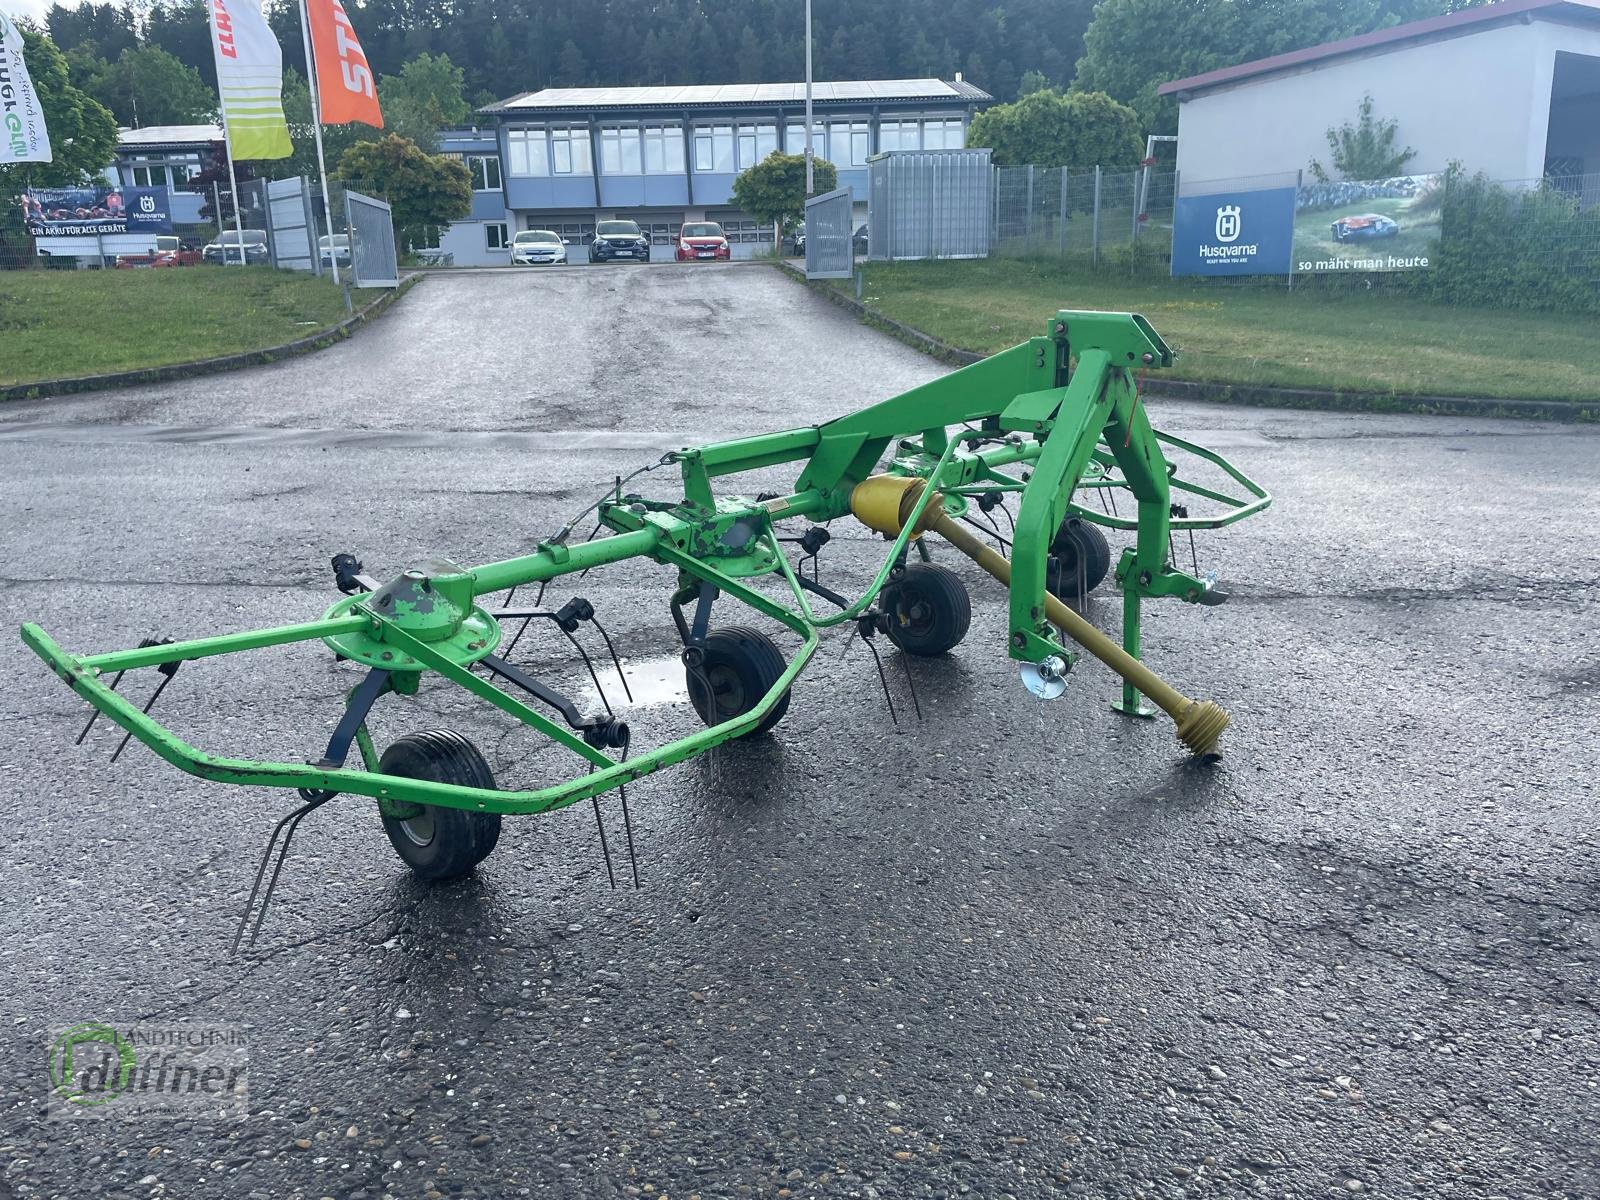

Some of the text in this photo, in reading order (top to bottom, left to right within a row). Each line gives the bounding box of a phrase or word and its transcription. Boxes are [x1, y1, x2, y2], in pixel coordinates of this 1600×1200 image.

[333, 0, 373, 99] STI
[132, 212, 166, 220] Husqvarna
[32, 223, 127, 236] EIN AKKU FÜR ALLE GERÄTE
[1199, 244, 1257, 259] Husqvarna
[1298, 255, 1429, 270] so mäht man heute
